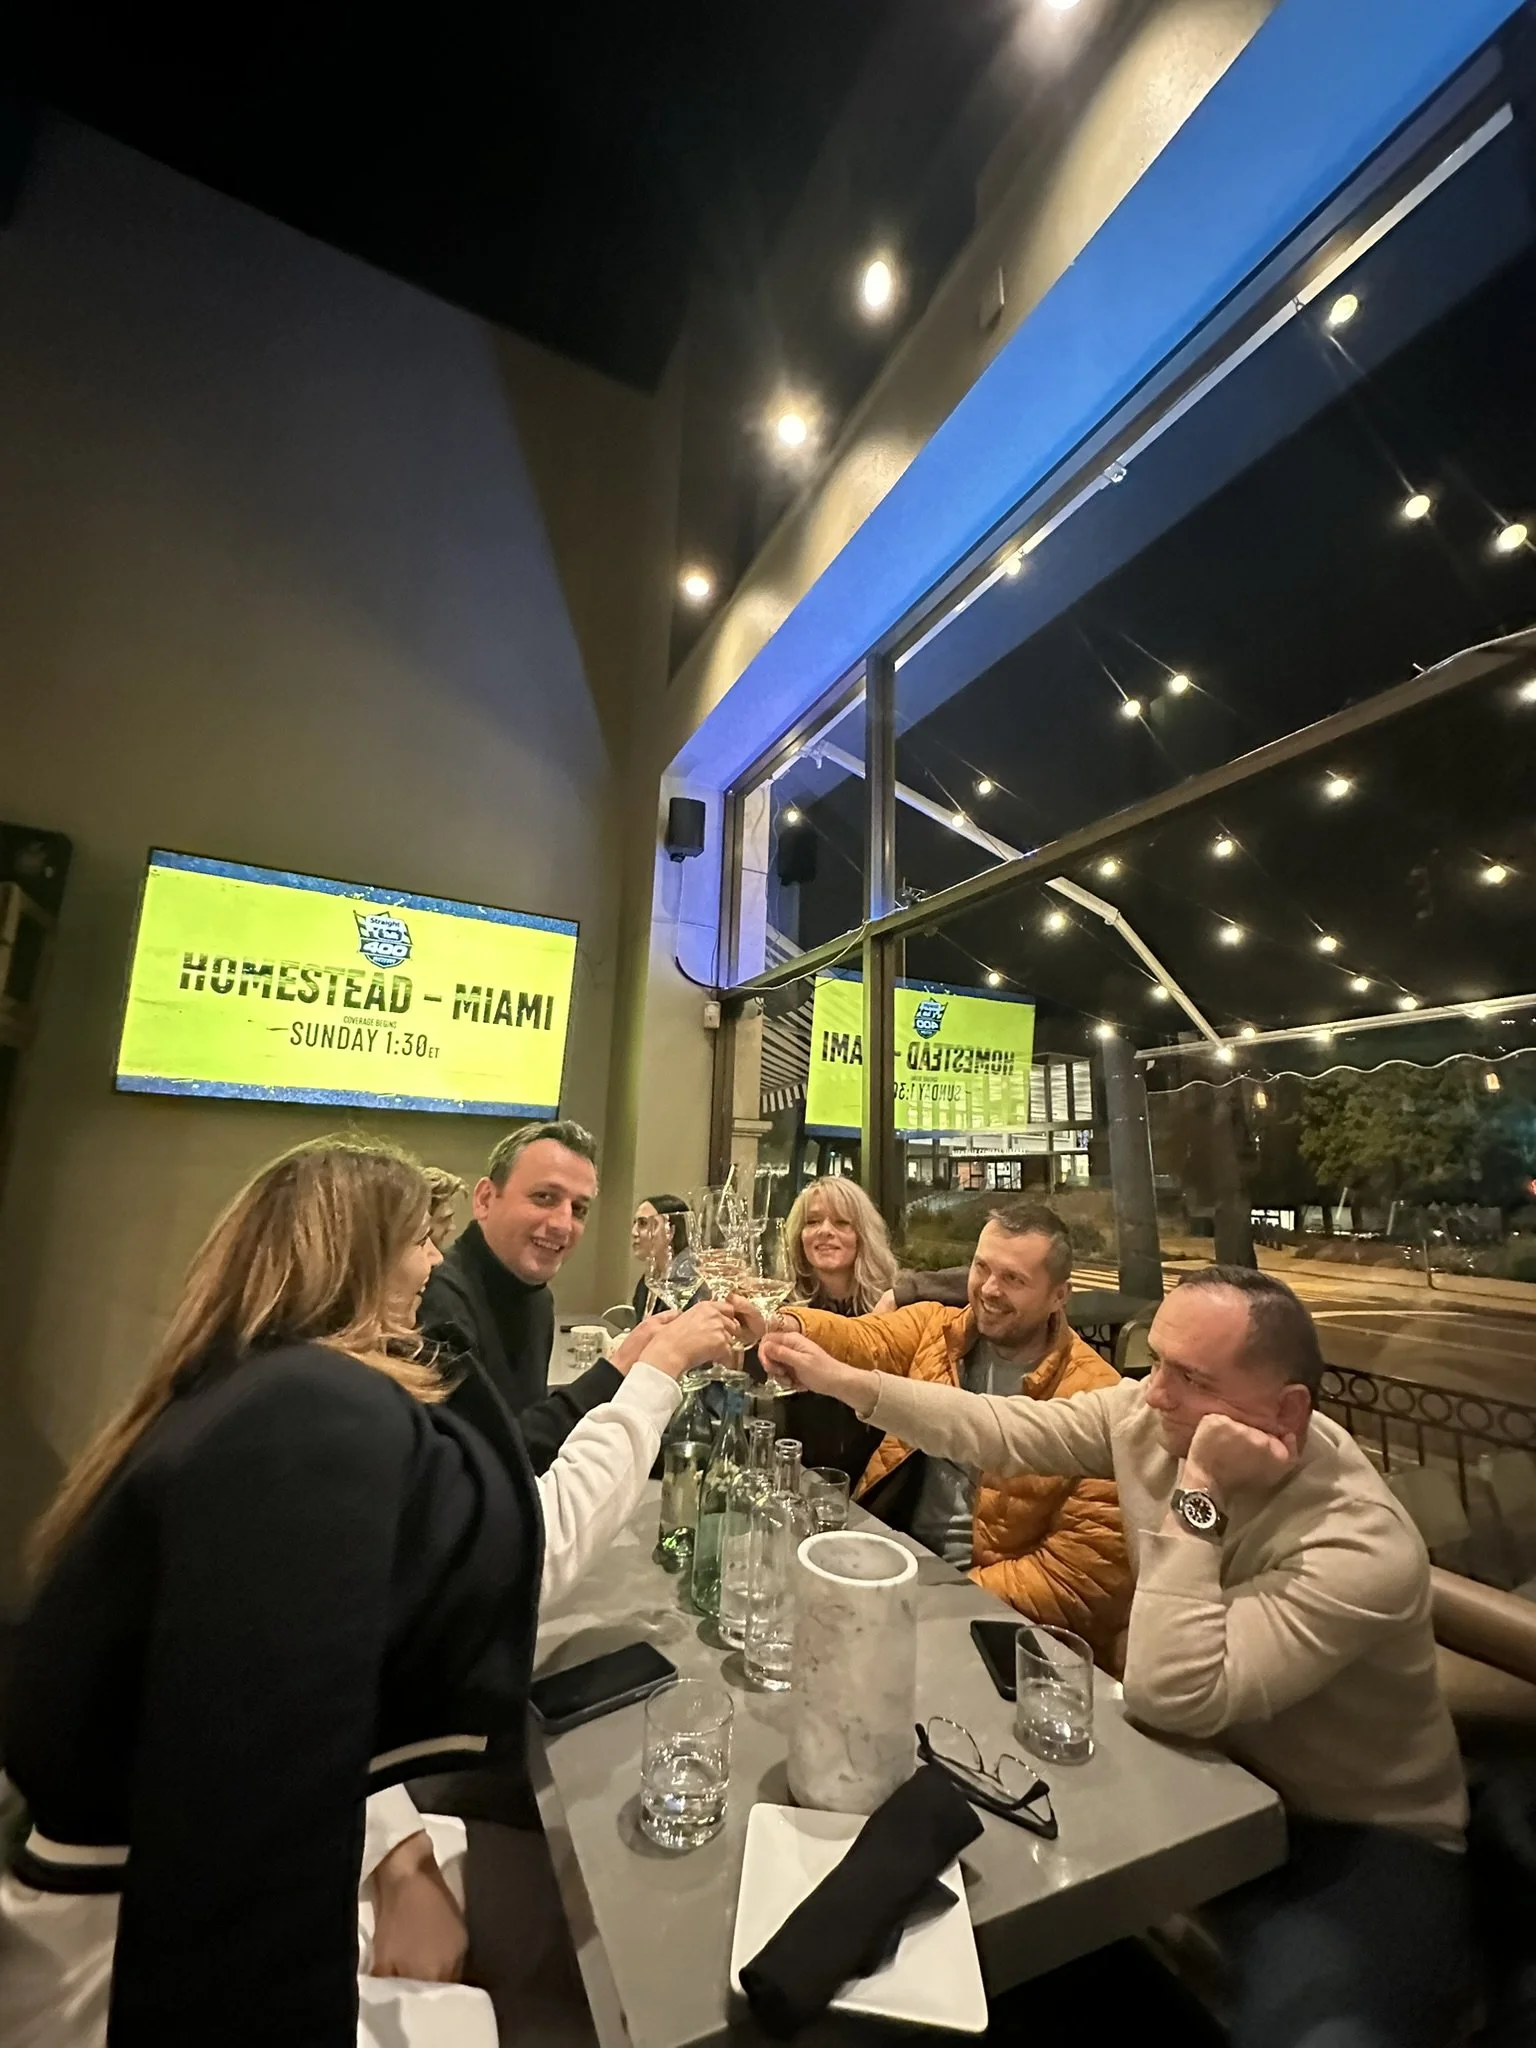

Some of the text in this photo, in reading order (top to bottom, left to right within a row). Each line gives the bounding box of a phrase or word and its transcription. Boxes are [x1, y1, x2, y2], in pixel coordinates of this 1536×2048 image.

[370, 917, 400, 927] Straight
[362, 942, 409, 957] 400
[179, 951, 413, 1014] HOMESTEAD
[452, 983, 554, 1031] MIAMI
[343, 1015, 397, 1029] COVERAGE BEGINS
[290, 1021, 378, 1052] SUNDAY
